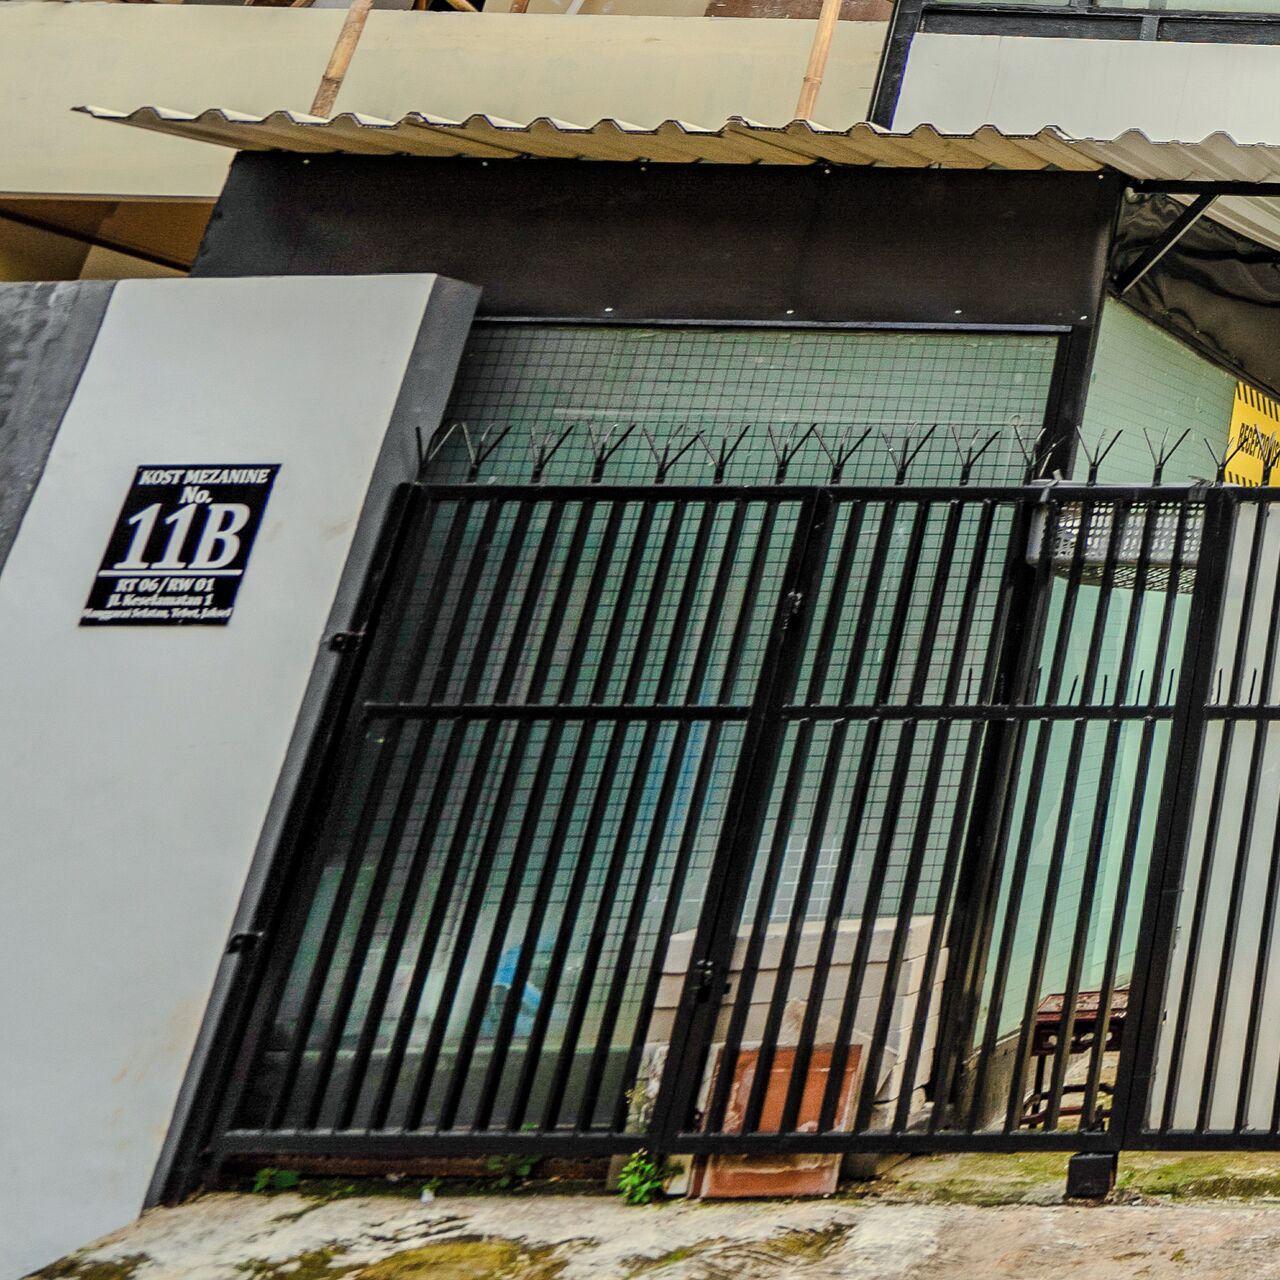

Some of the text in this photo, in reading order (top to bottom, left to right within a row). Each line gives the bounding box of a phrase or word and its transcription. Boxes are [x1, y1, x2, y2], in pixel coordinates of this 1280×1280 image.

[139, 468, 271, 485] KOST MEZANINE
[178, 485, 213, 504] No.
[113, 503, 250, 569] 11B
